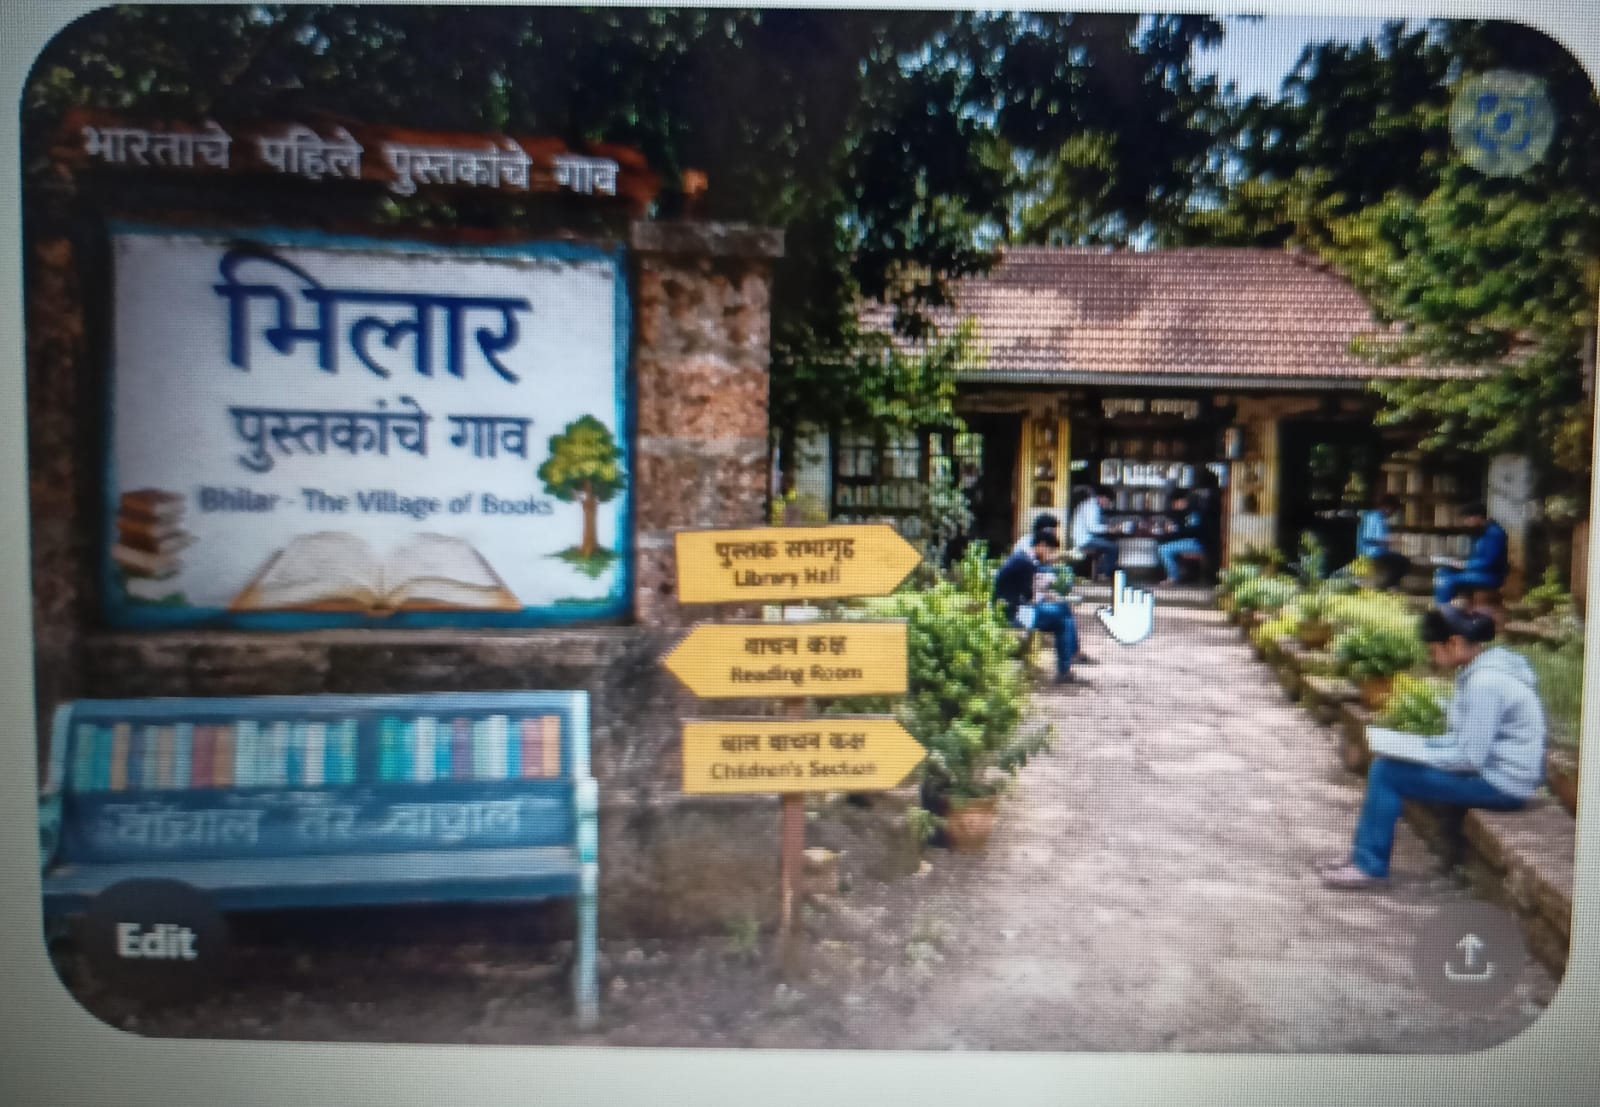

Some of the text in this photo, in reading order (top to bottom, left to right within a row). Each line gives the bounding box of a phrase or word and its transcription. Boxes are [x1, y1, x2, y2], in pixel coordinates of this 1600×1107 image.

[80, 120, 621, 197] भारताचे पहिले पुस्तकांचे गाव
[213, 249, 534, 384] भिलार
[227, 396, 534, 474] पुस्तकांचे गाव
[199, 485, 278, 513] Bhilar
[302, 487, 349, 513] The
[356, 489, 441, 520] Village
[448, 491, 473, 514] of
[480, 492, 554, 516] Books
[734, 566, 840, 588] Library Hall
[731, 664, 863, 687] Reading Room
[710, 760, 877, 780] Children's Section
[116, 922, 199, 960] Edit
